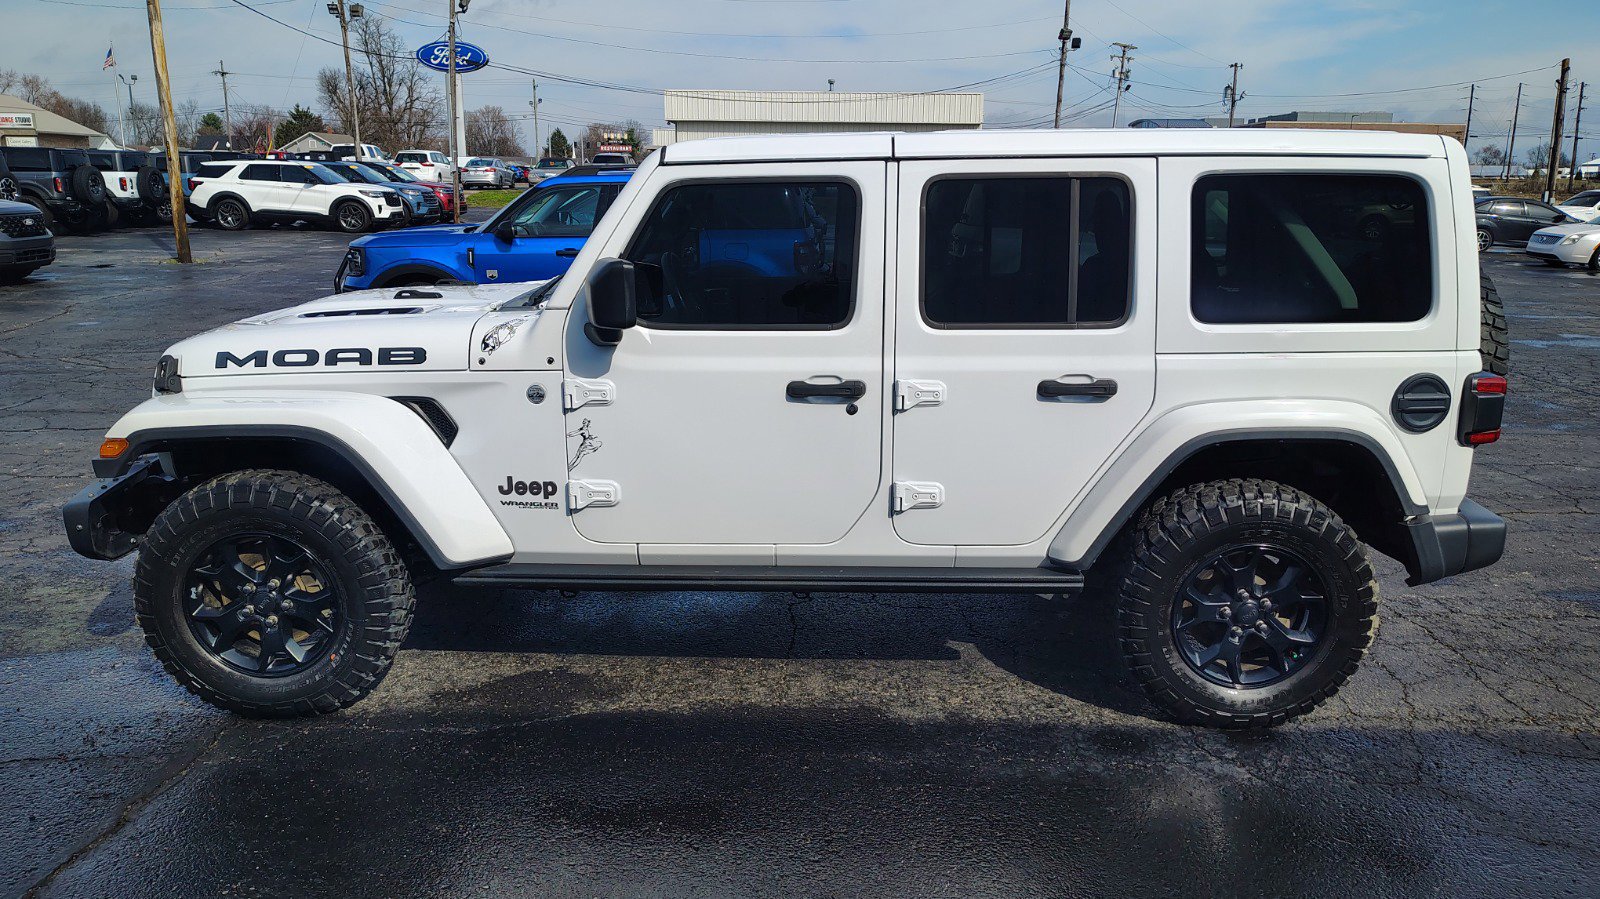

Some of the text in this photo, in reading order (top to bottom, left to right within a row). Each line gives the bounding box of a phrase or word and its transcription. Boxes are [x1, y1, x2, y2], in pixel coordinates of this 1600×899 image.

[215, 347, 427, 369] MOAB
[497, 475, 558, 500] Jeep
[499, 500, 559, 508] WRANGLER
